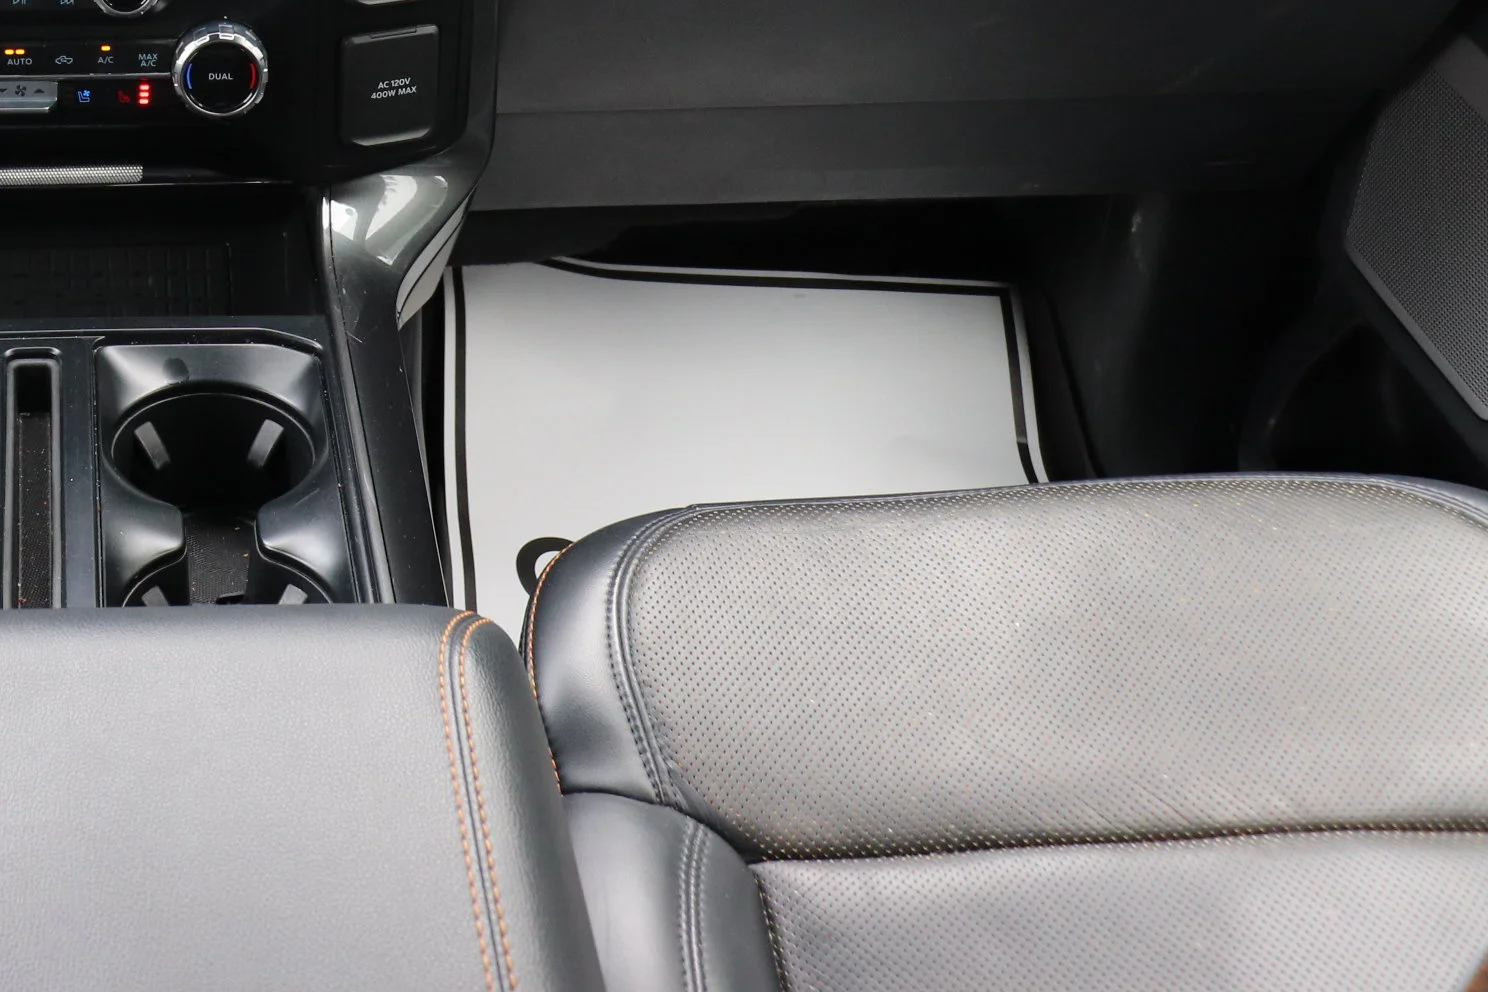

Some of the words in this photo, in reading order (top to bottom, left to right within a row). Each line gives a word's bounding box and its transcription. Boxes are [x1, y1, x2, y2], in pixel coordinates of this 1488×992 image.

[97, 56, 114, 64] A/C
[138, 53, 158, 61] MAX
[7, 58, 32, 66] AUTO
[140, 60, 157, 68] A/C
[208, 73, 233, 81] DUAL
[377, 81, 389, 90] AC
[390, 77, 411, 88] 120V
[371, 88, 396, 99] 400W
[397, 86, 417, 96] MAX
